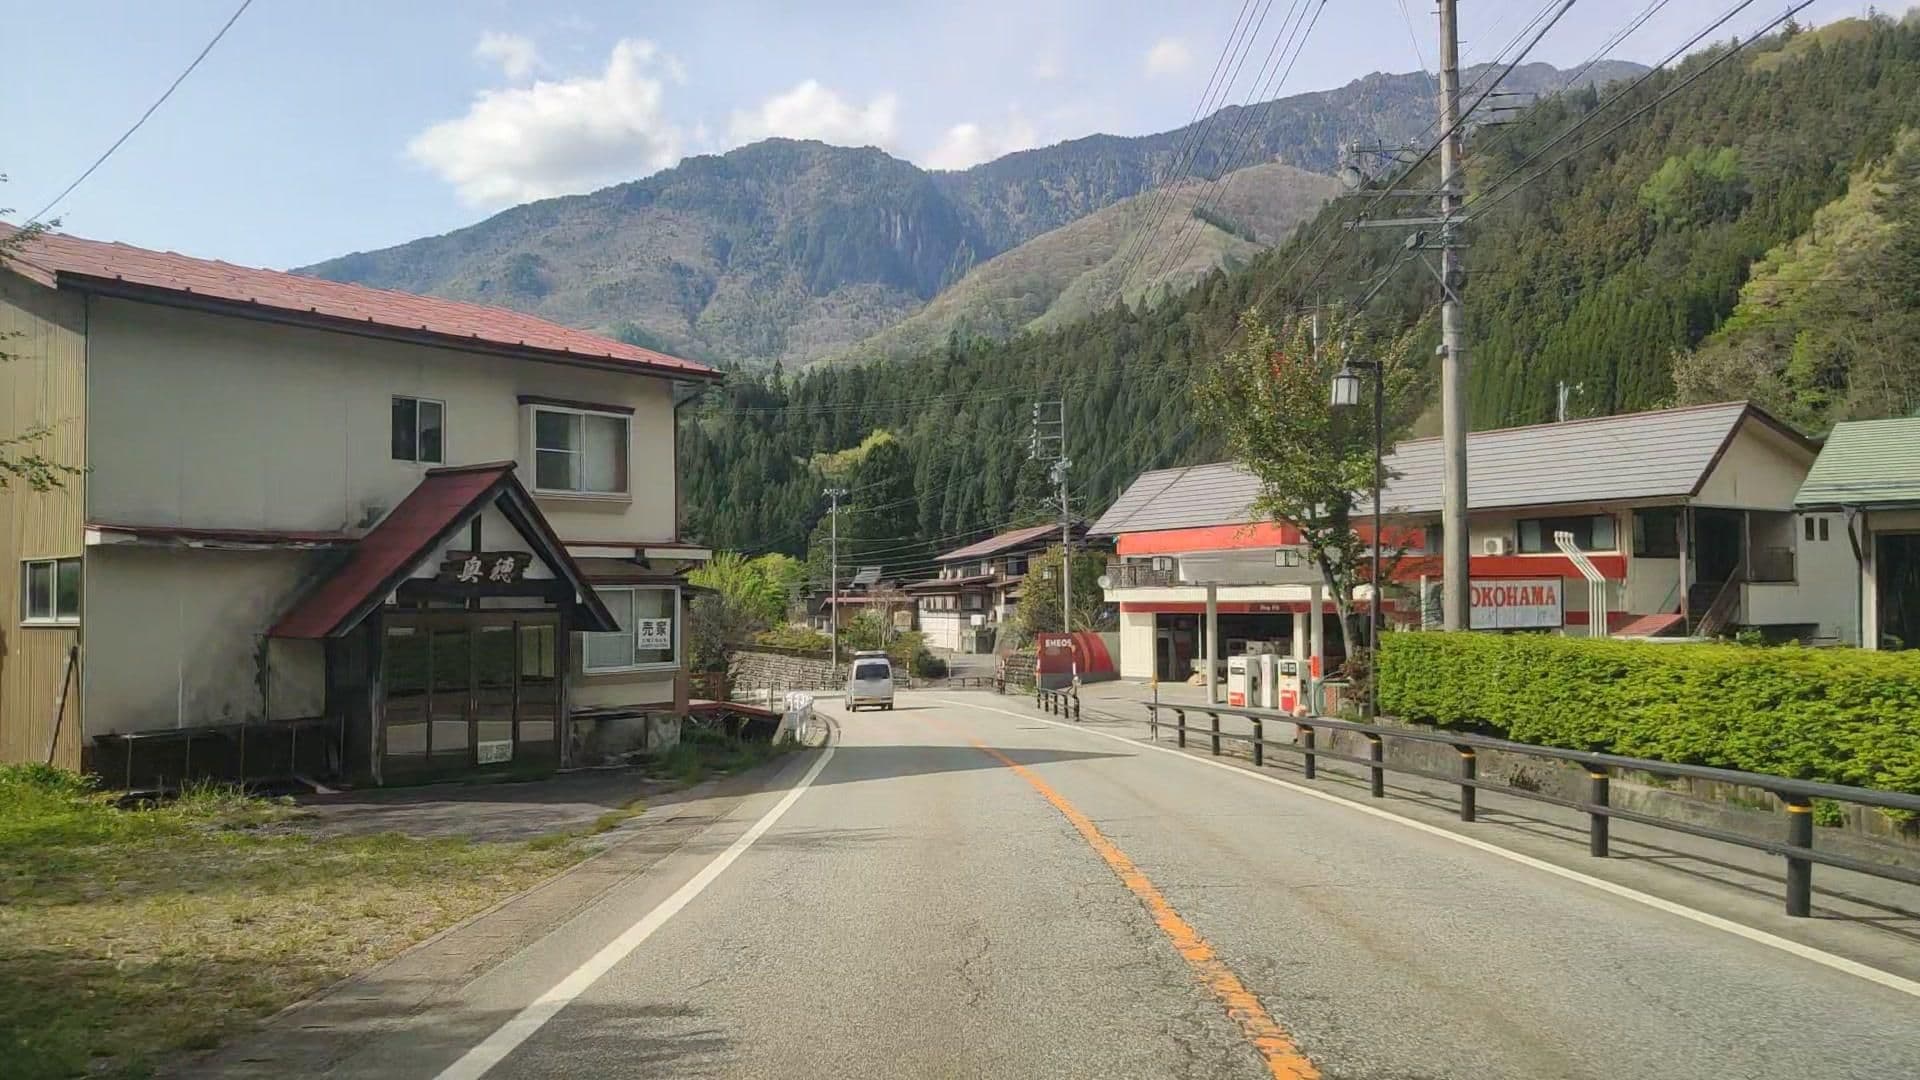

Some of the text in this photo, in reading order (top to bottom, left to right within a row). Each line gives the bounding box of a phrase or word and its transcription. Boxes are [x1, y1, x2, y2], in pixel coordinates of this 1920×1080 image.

[1470, 586, 1556, 607] OKOHAMA
[642, 621, 667, 636] 売家
[1045, 639, 1072, 647] ENEOS
